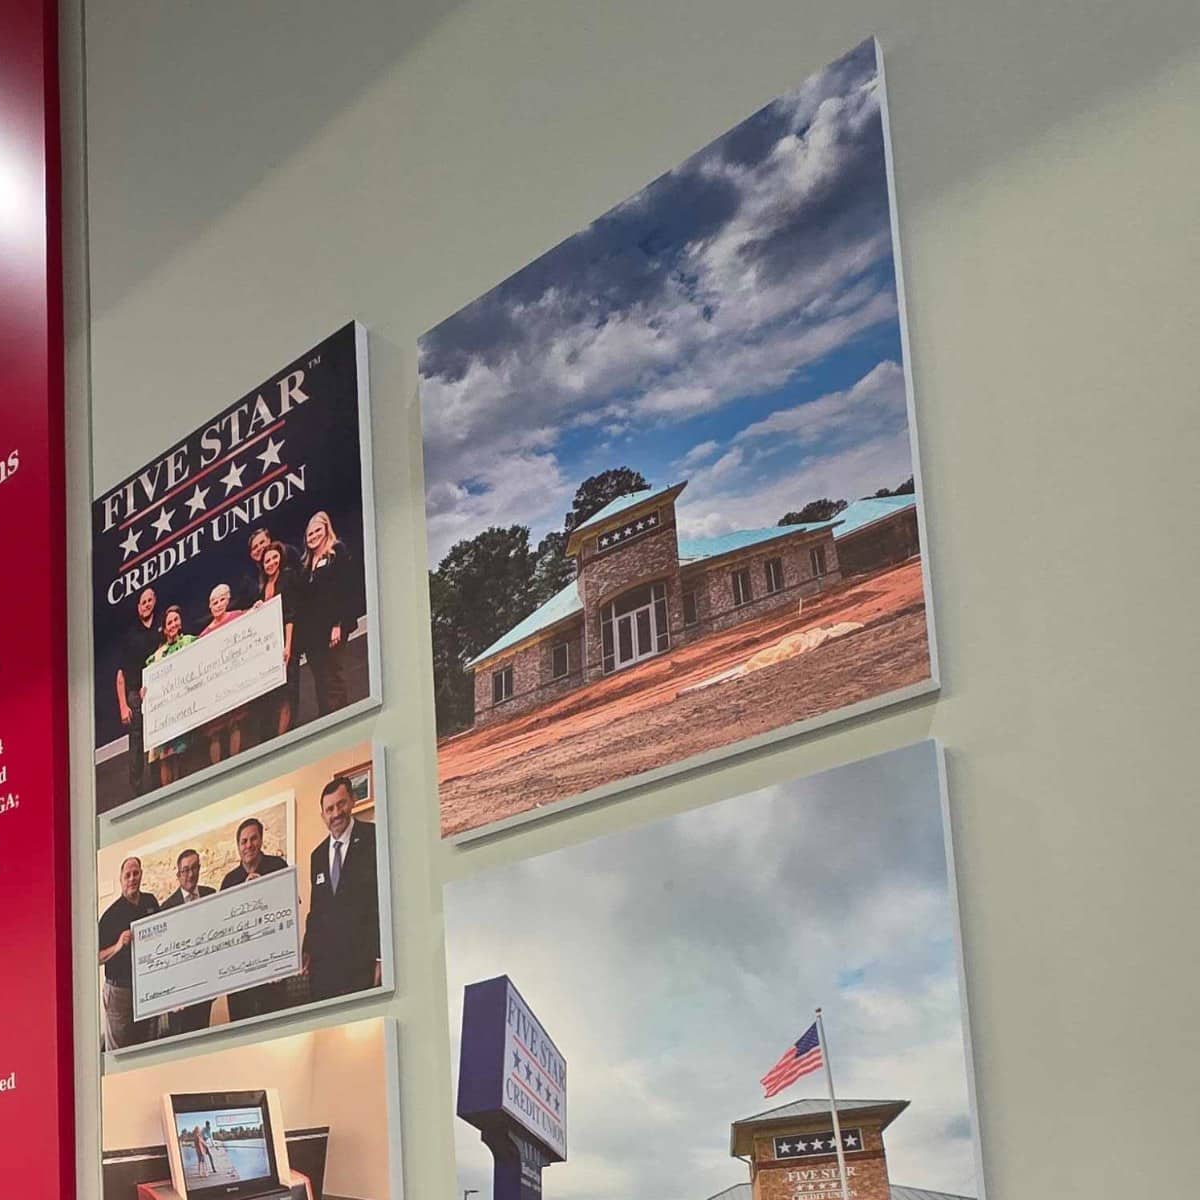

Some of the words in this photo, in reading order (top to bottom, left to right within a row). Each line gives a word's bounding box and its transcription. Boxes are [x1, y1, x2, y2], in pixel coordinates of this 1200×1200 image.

[102, 445, 190, 533] FIVE
[200, 369, 309, 468] STAR
[107, 529, 204, 605] CREDIT
[211, 464, 306, 542] UNION
[508, 997, 537, 1057] FIVE
[540, 1040, 566, 1092] STAR
[506, 1078, 541, 1122] CREDIT
[788, 1170, 818, 1181] FIVE
[821, 1166, 856, 1178] STR
